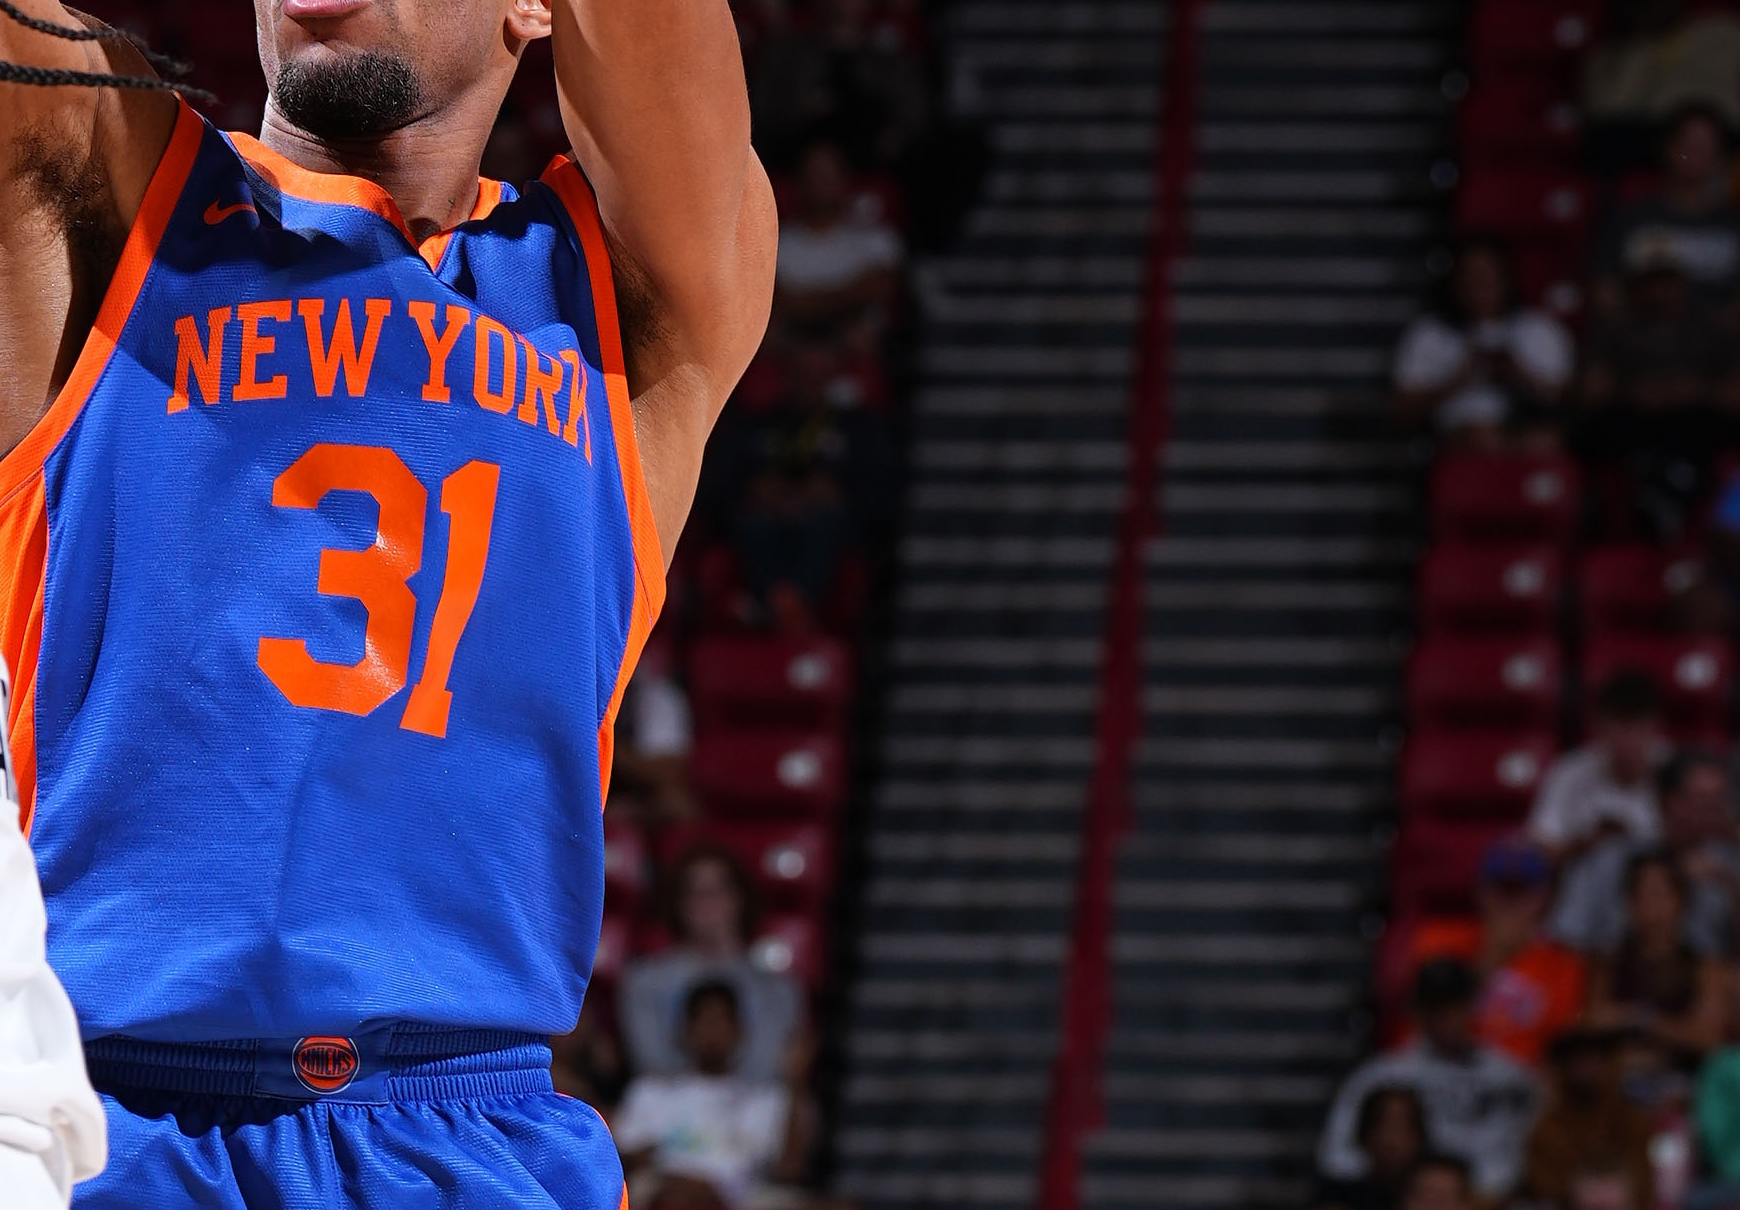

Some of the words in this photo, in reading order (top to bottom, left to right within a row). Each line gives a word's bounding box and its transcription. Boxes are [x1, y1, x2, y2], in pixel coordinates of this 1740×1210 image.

[167, 298, 392, 415] NEW
[408, 300, 593, 467] YORK
[257, 442, 501, 739] 31
